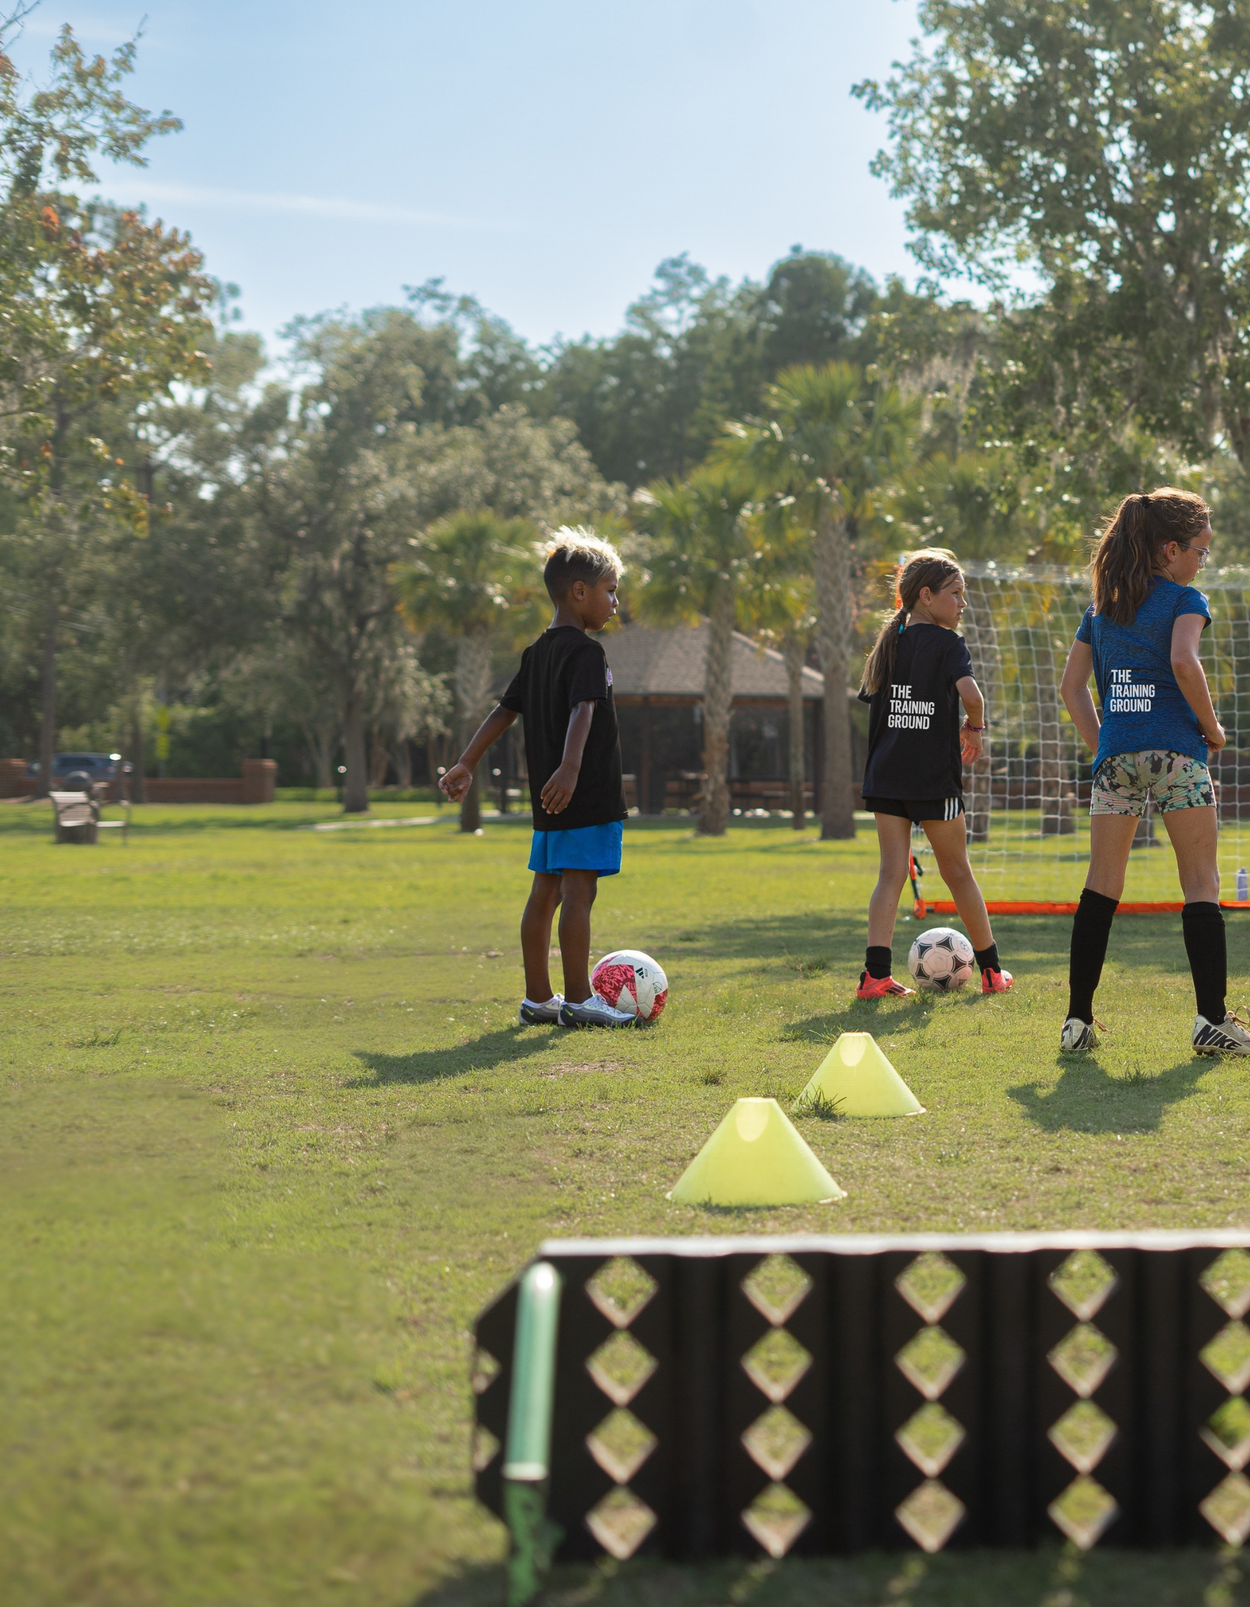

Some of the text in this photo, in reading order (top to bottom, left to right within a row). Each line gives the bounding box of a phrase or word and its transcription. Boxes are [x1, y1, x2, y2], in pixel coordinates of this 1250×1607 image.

[1110, 669, 1132, 683] THE
[891, 684, 912, 699] THE
[1110, 684, 1155, 698] TRAINING
[889, 699, 935, 715] TRAINING
[1110, 698, 1152, 712] GROUND
[887, 714, 930, 730] GROUND
[1193, 1023, 1243, 1051] NIKE
